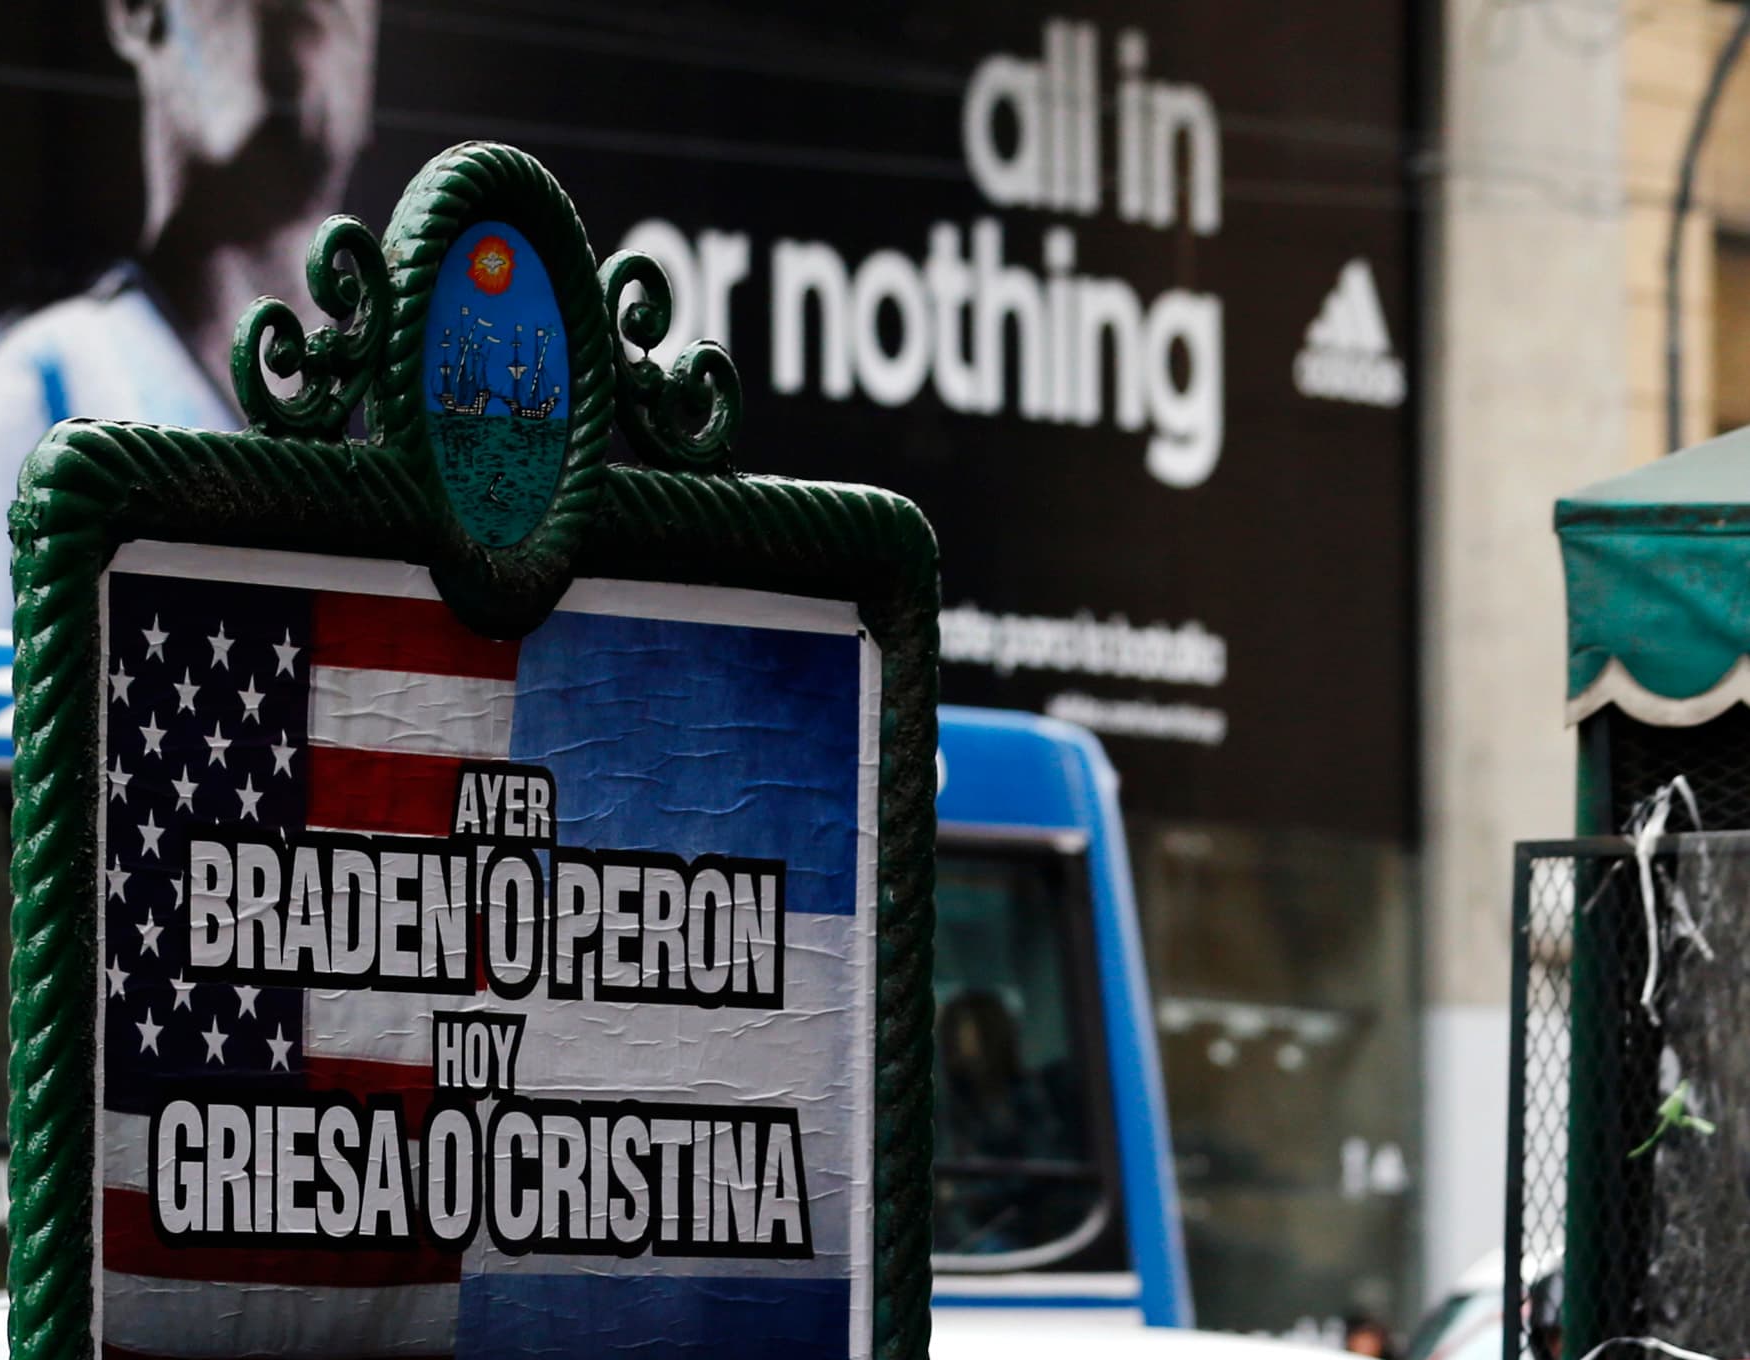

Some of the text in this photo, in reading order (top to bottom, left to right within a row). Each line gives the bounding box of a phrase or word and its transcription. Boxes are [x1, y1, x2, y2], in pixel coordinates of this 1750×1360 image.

[964, 19, 1221, 236] all in
[617, 217, 1223, 489] or nothing
[455, 772, 549, 837] AYER
[189, 840, 776, 994] BRADEN O PERON
[437, 1021, 518, 1090] HOY
[157, 1100, 804, 1245] GRIESA O CRISTINA
